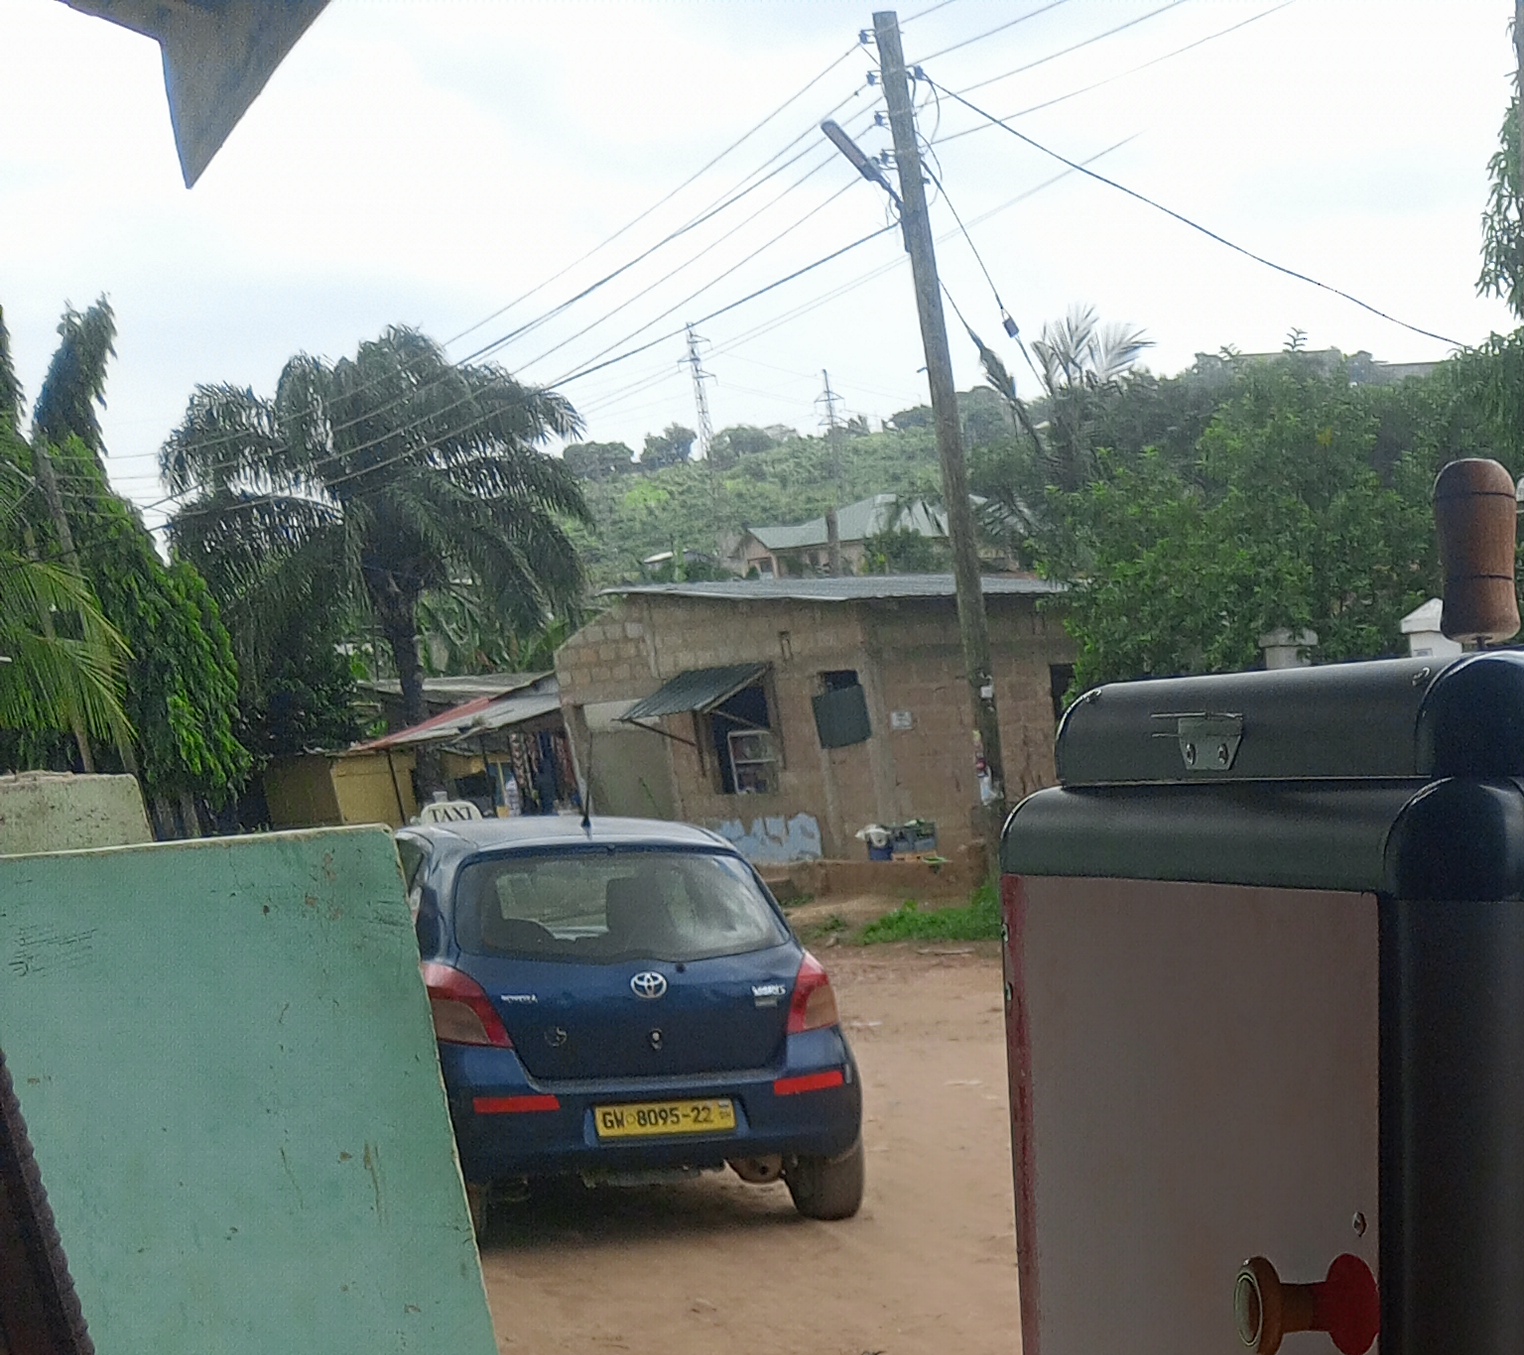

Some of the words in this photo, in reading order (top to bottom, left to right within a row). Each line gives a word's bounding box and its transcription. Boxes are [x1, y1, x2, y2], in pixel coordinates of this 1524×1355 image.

[429, 806, 473, 823] TAXI
[602, 1109, 625, 1129] GW
[636, 1106, 714, 1127] 8095-22
